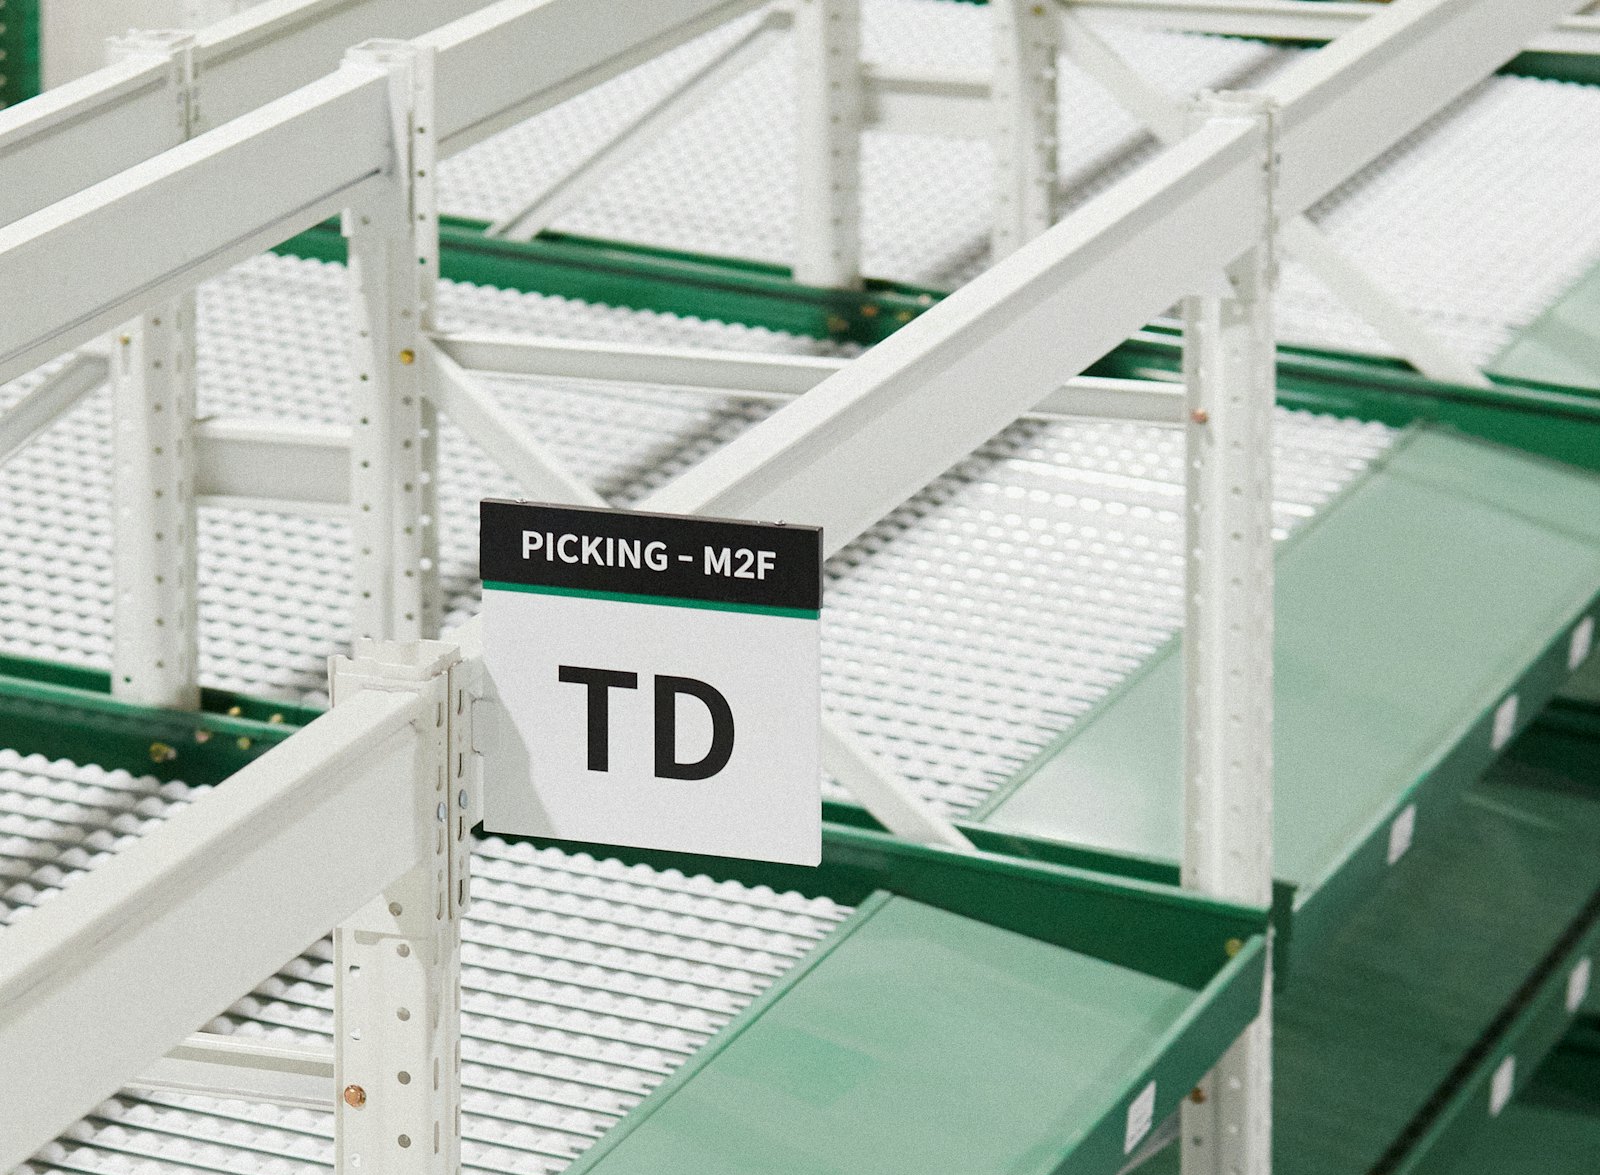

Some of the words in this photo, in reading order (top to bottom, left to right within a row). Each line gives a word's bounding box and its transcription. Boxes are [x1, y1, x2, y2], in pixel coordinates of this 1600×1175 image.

[522, 530, 668, 572] PICKING
[703, 545, 777, 580] M2F
[558, 664, 735, 781] TD
